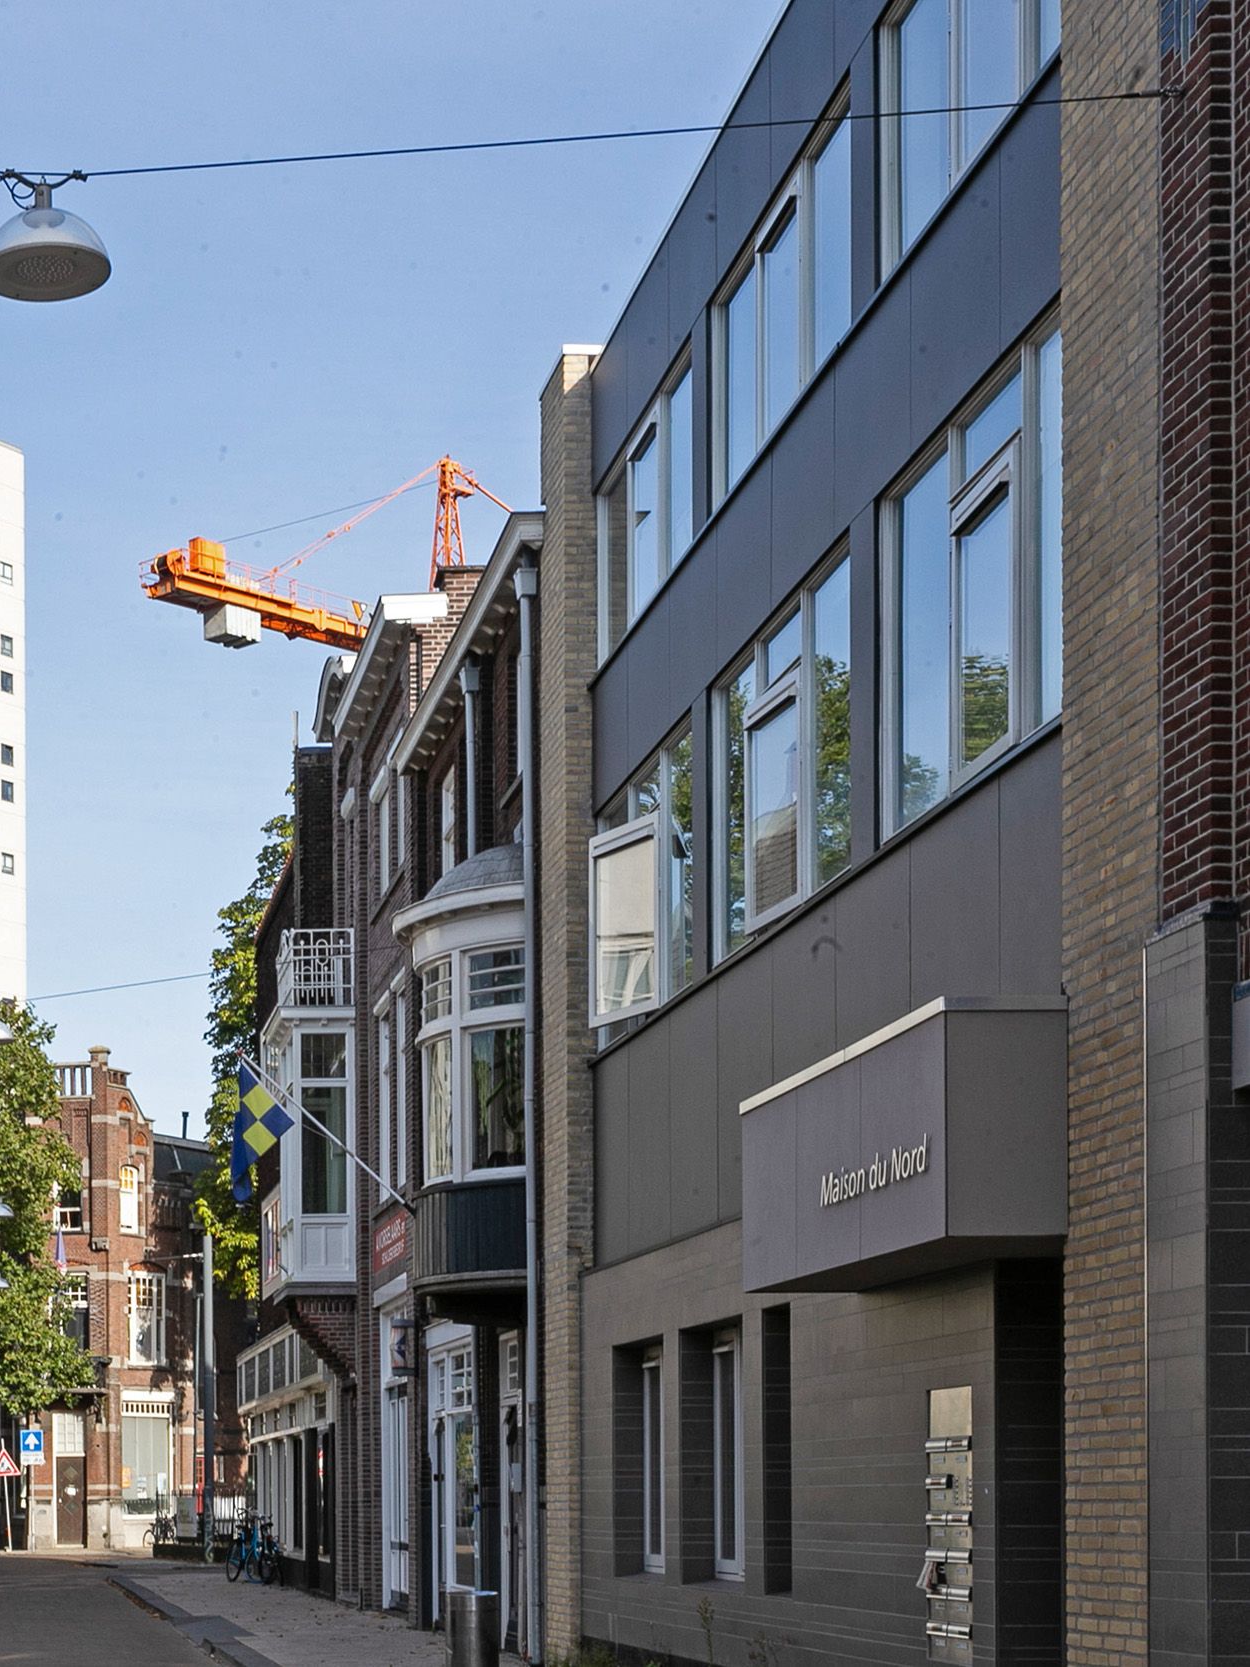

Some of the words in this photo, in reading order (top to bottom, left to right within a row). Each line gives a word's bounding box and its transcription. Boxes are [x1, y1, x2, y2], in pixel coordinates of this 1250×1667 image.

[820, 1166, 865, 1207] Maison
[868, 1152, 887, 1190] du
[890, 1132, 927, 1183] Nord
